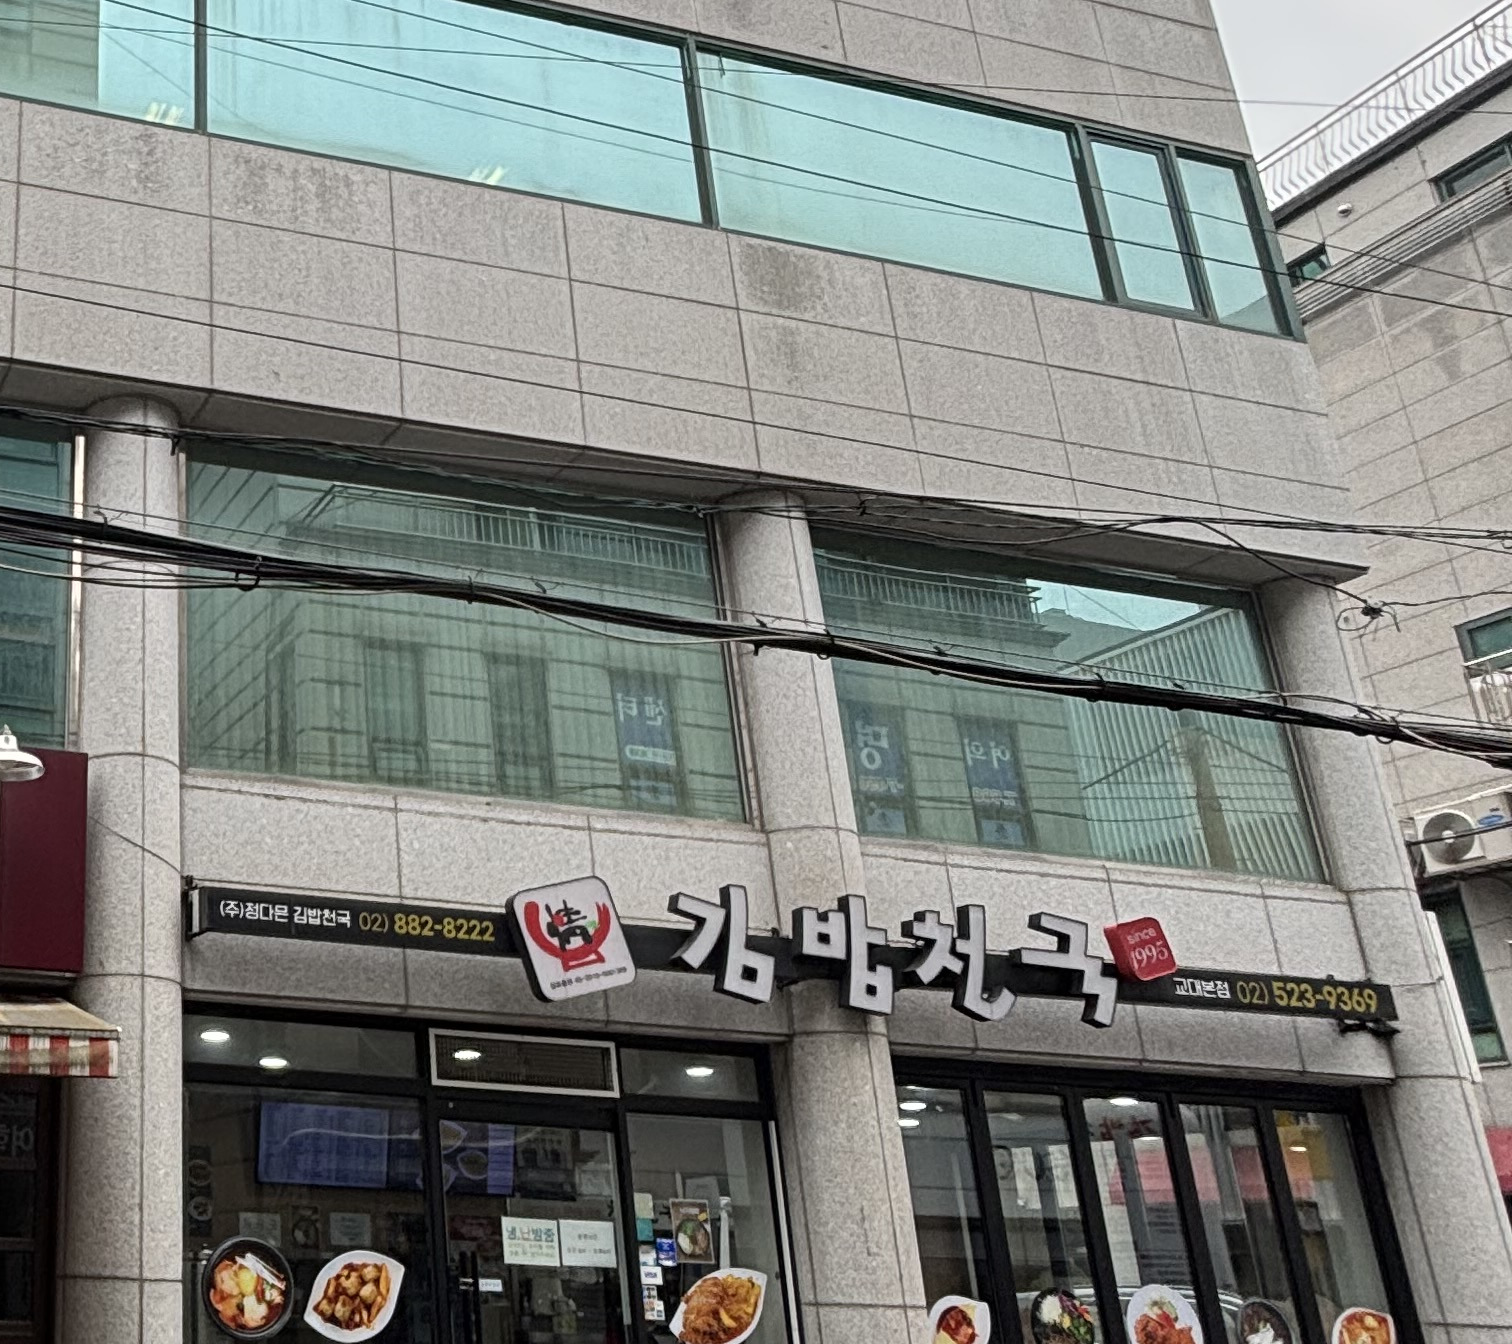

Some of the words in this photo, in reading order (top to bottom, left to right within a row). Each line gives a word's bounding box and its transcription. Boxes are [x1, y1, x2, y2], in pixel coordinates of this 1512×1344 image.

[292, 906, 351, 927] 김밥천국
[359, 912, 389, 933] 02)
[394, 913, 495, 941] 882-8222
[1127, 925, 1157, 945] since
[668, 884, 1118, 1027] 김밥천국
[1129, 940, 1169, 969] 1995
[1173, 977, 1231, 999] 교대본점
[1237, 981, 1269, 1005] 02)
[1272, 981, 1378, 1013] 523-9369
